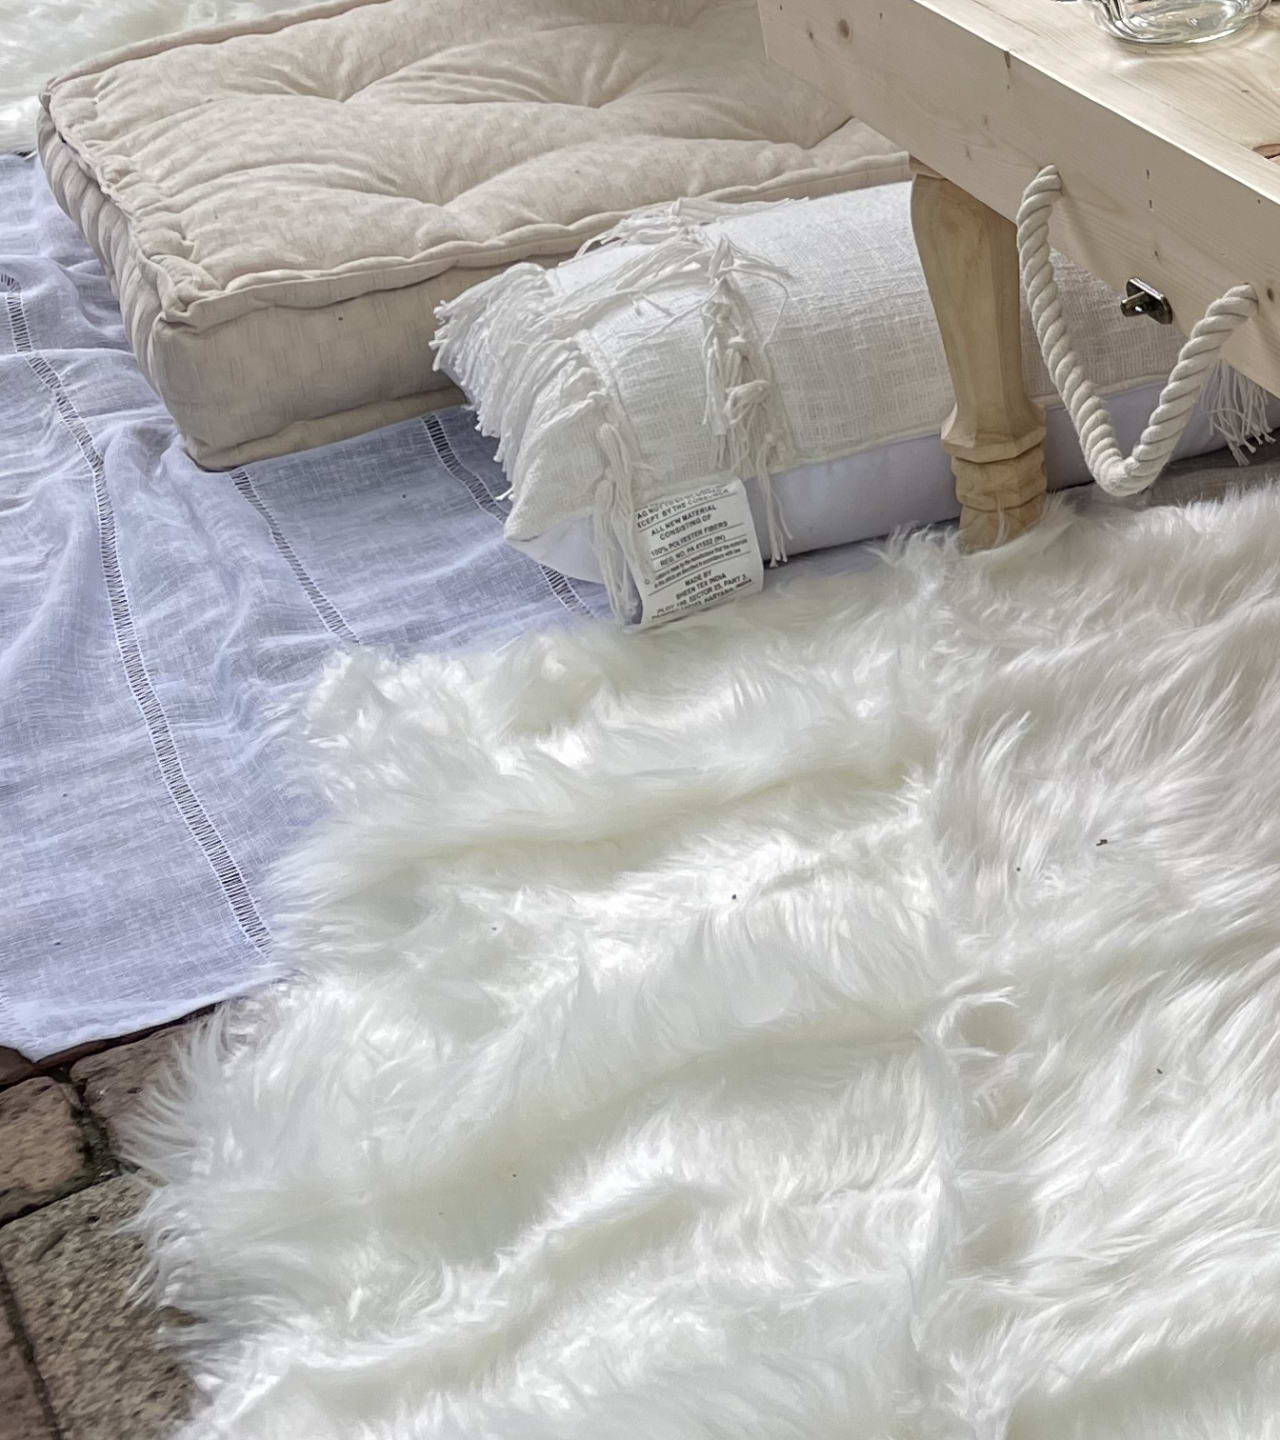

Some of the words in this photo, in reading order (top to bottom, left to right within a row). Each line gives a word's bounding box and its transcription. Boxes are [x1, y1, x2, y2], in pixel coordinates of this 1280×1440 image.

[637, 509, 648, 520] AG
[651, 526, 664, 536] ALL
[665, 517, 681, 529] NEW
[681, 504, 717, 521] MATERIAL
[661, 508, 672, 517] BY
[672, 502, 686, 512] THE
[651, 547, 668, 556] 100%
[668, 529, 703, 549] POLYESTER
[704, 521, 728, 533] FIBERS
[659, 518, 701, 540] CONSISTING
[702, 513, 711, 521] OF
[676, 587, 696, 600] SHEEN
[696, 581, 708, 590] TEX
[709, 573, 727, 583] INDIA
[684, 574, 702, 586] MADE
[703, 569, 712, 578] BY
[689, 586, 712, 602] SECTOR
[724, 575, 740, 586] PART
